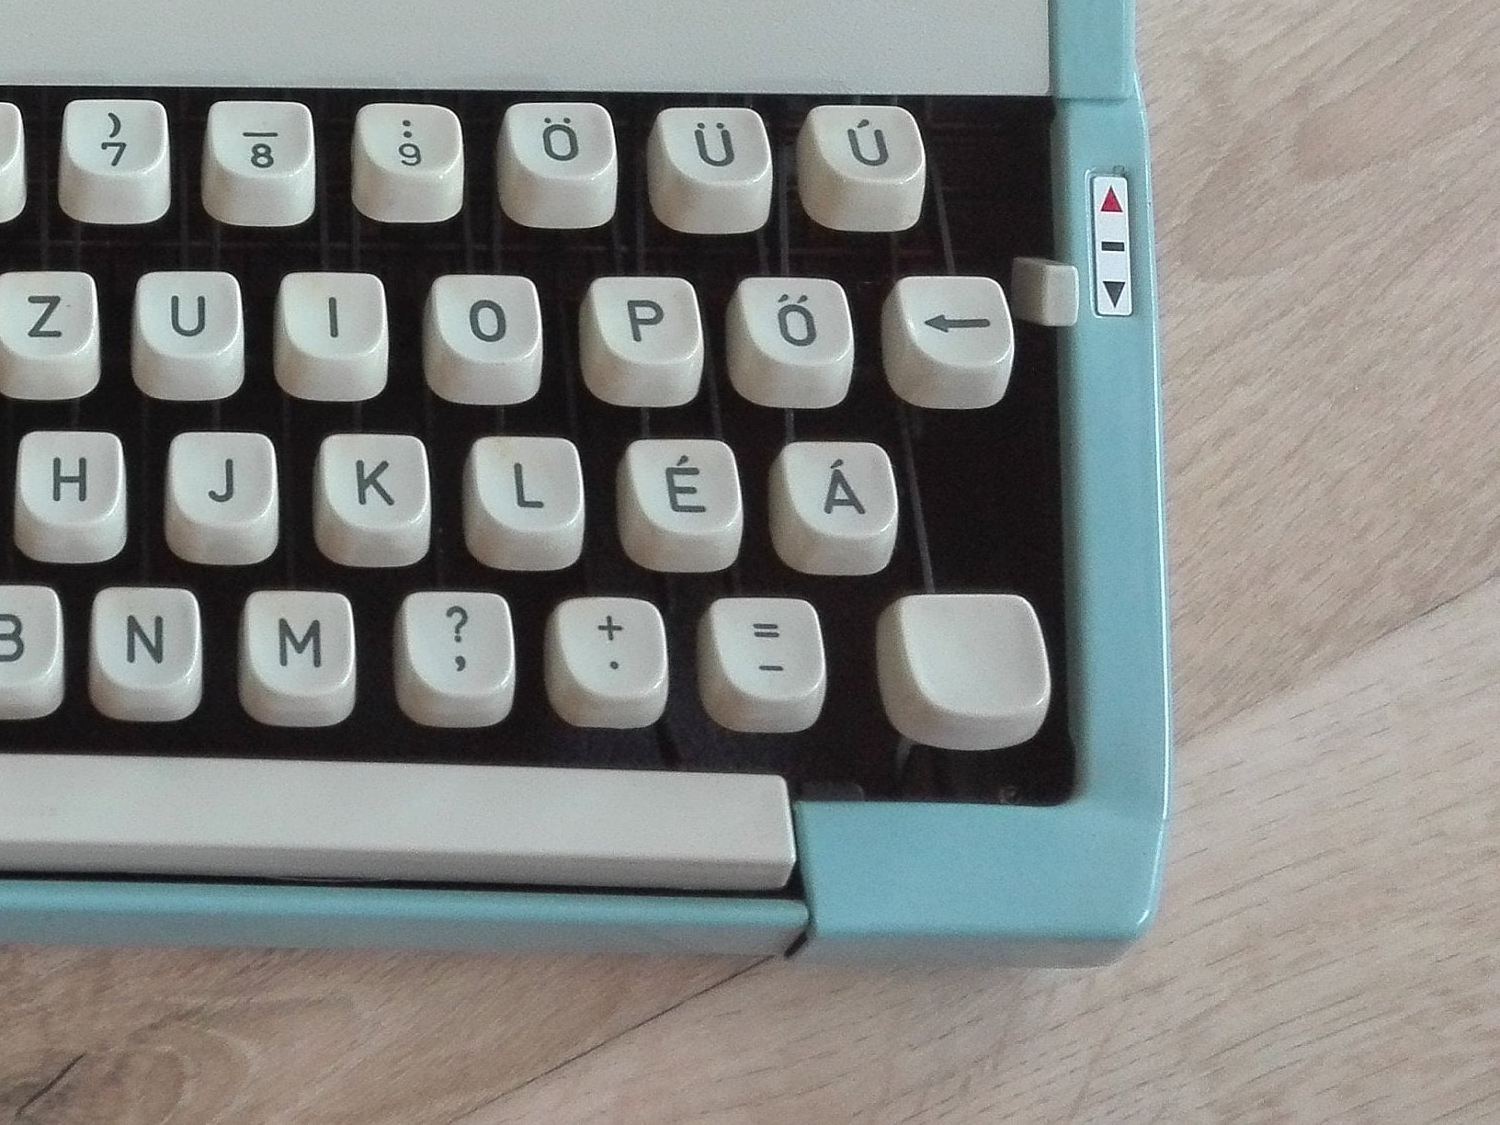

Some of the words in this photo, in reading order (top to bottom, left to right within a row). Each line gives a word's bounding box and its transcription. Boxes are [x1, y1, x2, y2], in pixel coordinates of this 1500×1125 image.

[107, 112, 122, 139] )
[402, 119, 413, 139] :
[542, 117, 579, 162] Ö
[694, 122, 735, 167] Ü
[847, 118, 889, 167] Ú
[100, 141, 127, 167] 7
[250, 143, 275, 169] 8
[398, 143, 422, 167] 9
[27, 295, 63, 338] Z
[171, 295, 206, 337] U
[328, 296, 339, 338] I
[469, 299, 507, 343] O
[626, 299, 665, 343] P
[777, 293, 817, 347] Ő
[52, 457, 87, 502] H
[208, 458, 234, 503] J
[355, 459, 395, 506] K
[513, 462, 545, 509] L
[665, 454, 707, 514] É
[823, 458, 866, 515] Á
[126, 614, 164, 664] N
[278, 617, 322, 668] M
[445, 605, 469, 643] ?
[597, 615, 624, 642] +
